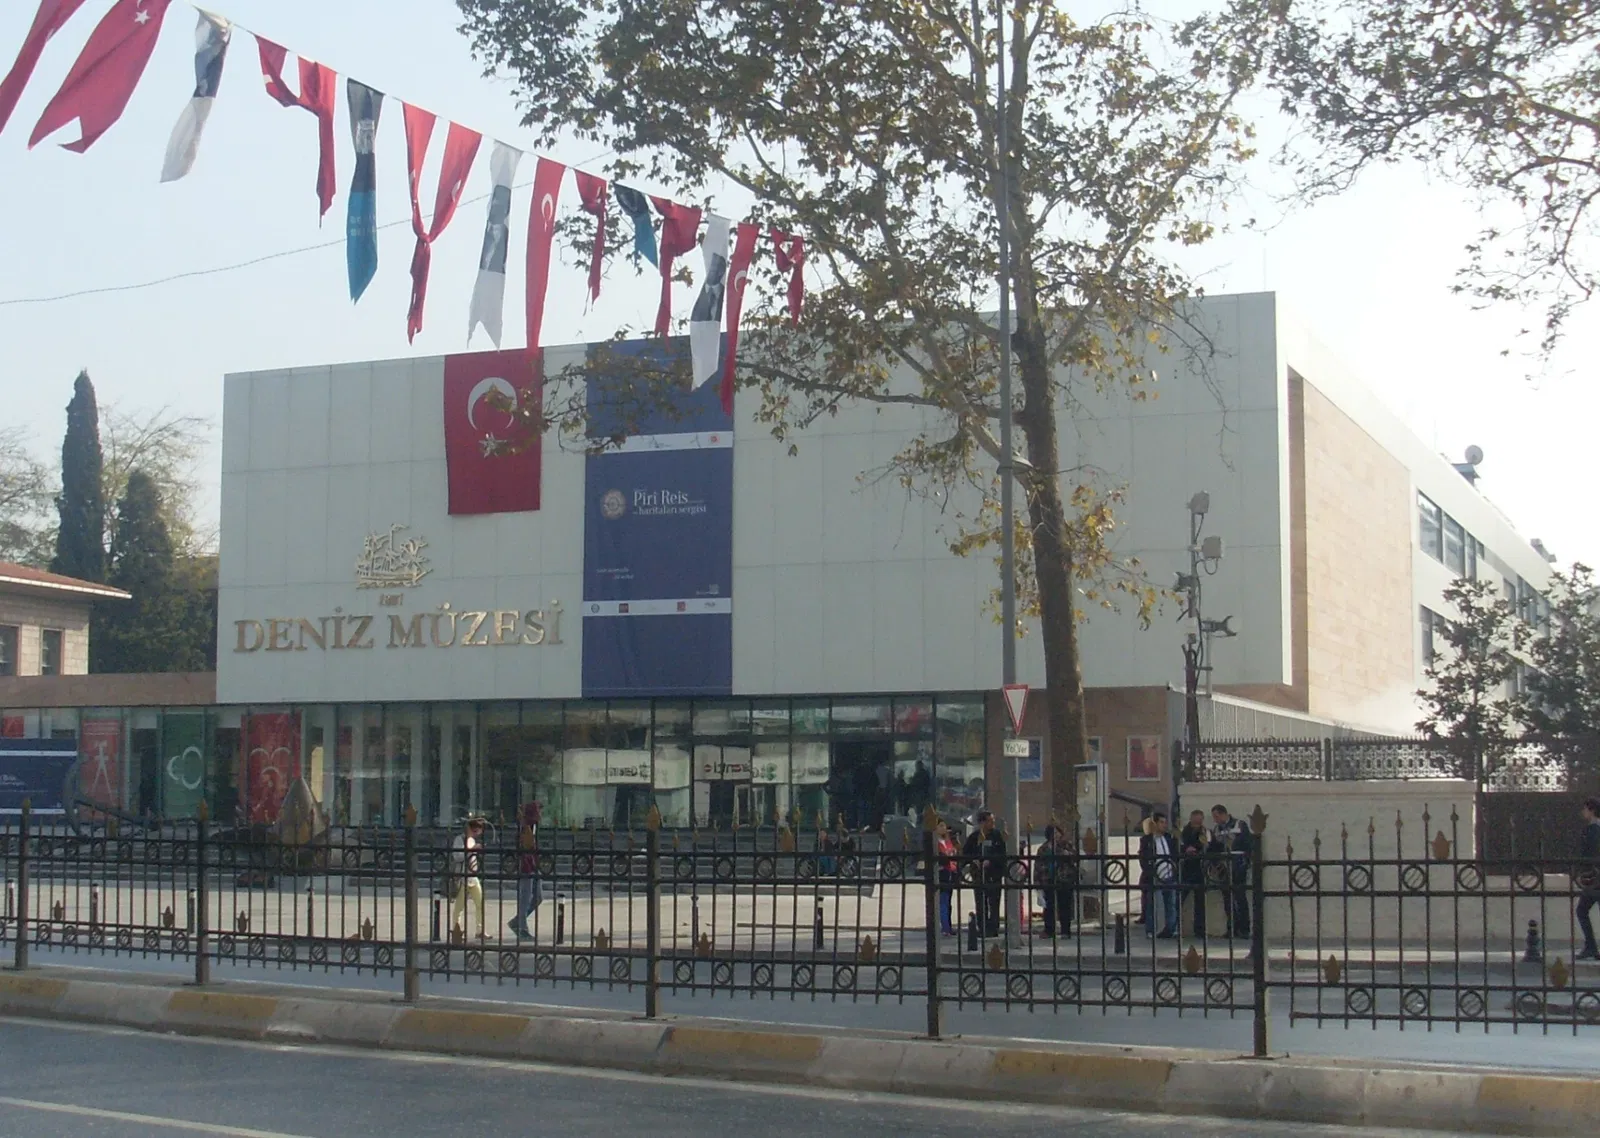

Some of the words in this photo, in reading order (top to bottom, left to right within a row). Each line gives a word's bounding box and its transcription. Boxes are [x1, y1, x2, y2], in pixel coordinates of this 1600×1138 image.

[634, 491, 657, 506] Piri
[661, 490, 688, 505] Reis
[233, 607, 375, 654] DENİZ
[386, 599, 564, 649] MÜZESİ
